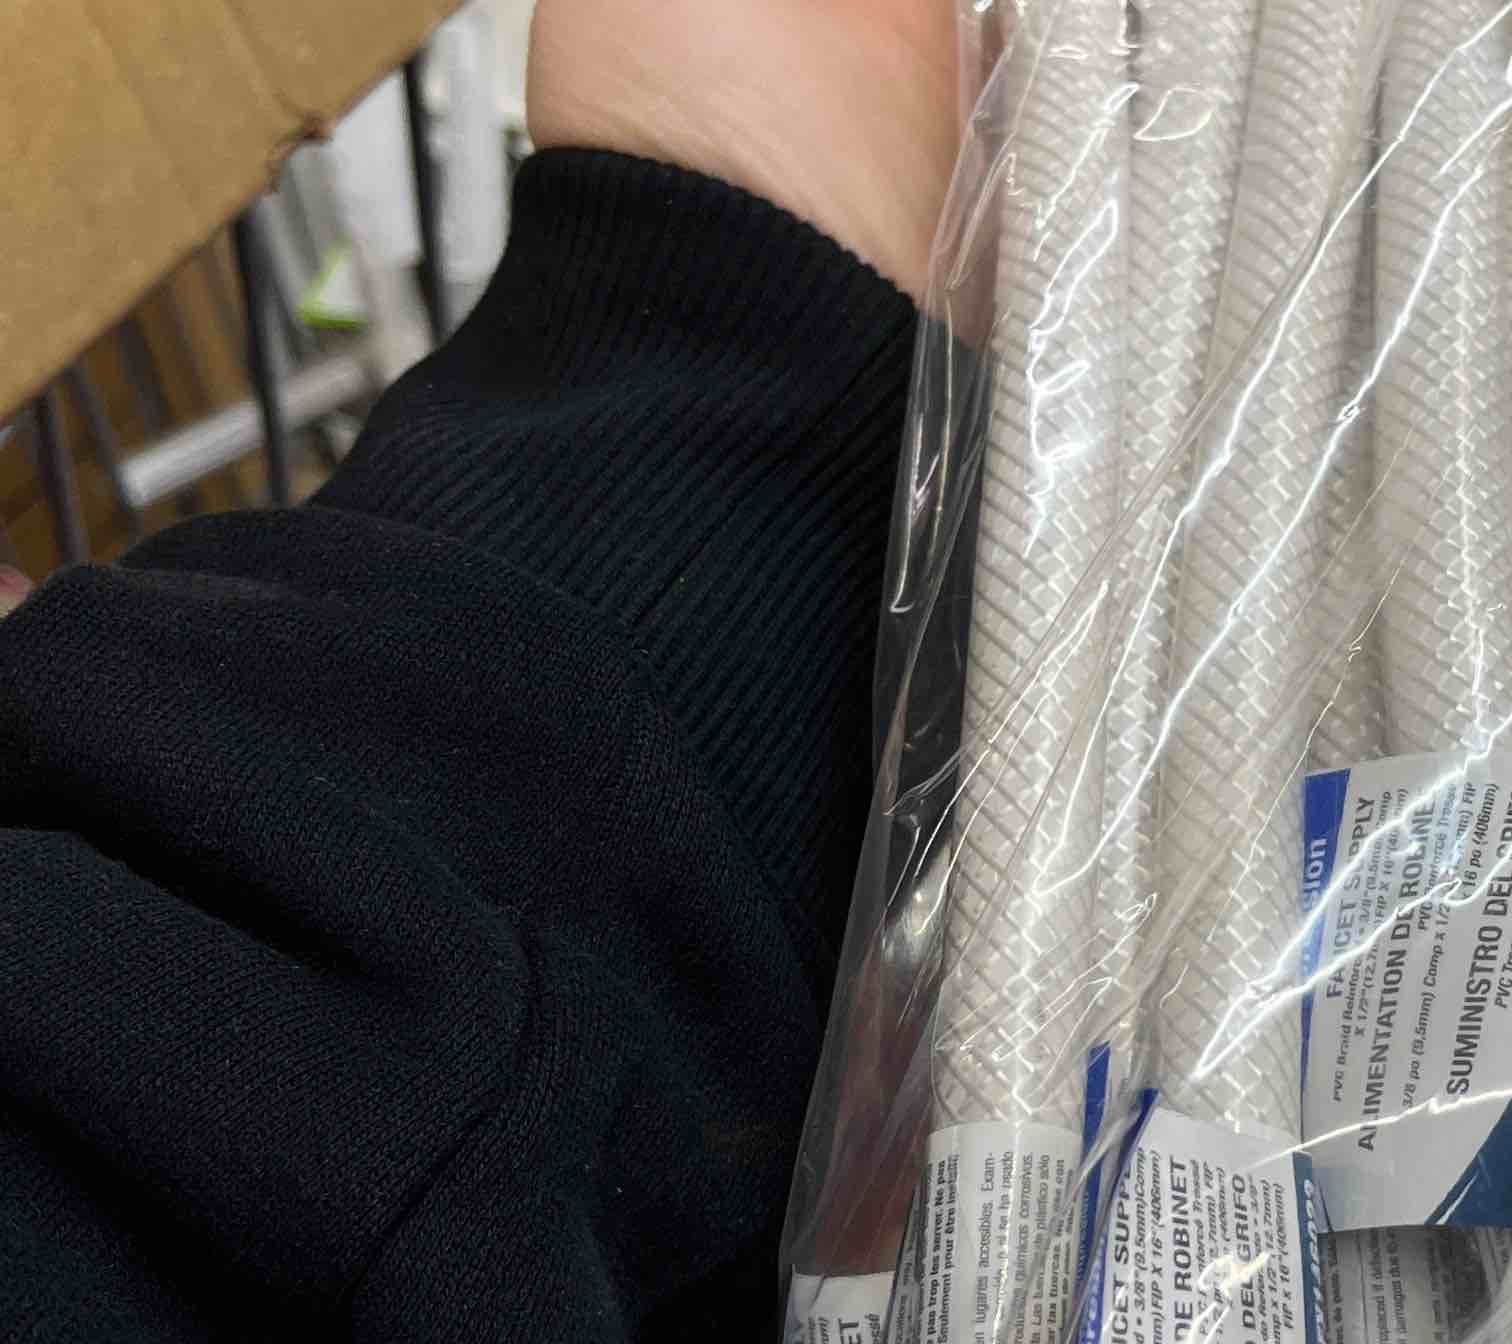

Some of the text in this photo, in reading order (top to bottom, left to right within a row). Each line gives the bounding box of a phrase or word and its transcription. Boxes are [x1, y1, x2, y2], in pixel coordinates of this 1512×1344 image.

[1459, 781, 1476, 805] FIP
[1343, 795, 1376, 891] SPPLY
[1462, 783, 1500, 888] 16 po (406mm)
[1423, 944, 1445, 987] Comp
[1409, 991, 1436, 1056] (9,5mm)
[1446, 925, 1504, 1096] SUMINISTRO
[1337, 1024, 1352, 1066] Braid
[1408, 1060, 1422, 1080] po
[1401, 1083, 1417, 1108] 3/8
[1112, 1160, 1131, 1265] SUPPL
[1168, 1155, 1192, 1292] ROBINET
[1231, 1173, 1252, 1262] GRIFO
[942, 1238, 956, 1270] pour
[1151, 1263, 1164, 1276] X
[927, 1279, 941, 1306] trop
[1239, 1275, 1257, 1330] DEL
[925, 1310, 938, 1335] pas
[1282, 1303, 1295, 1330] FIP
